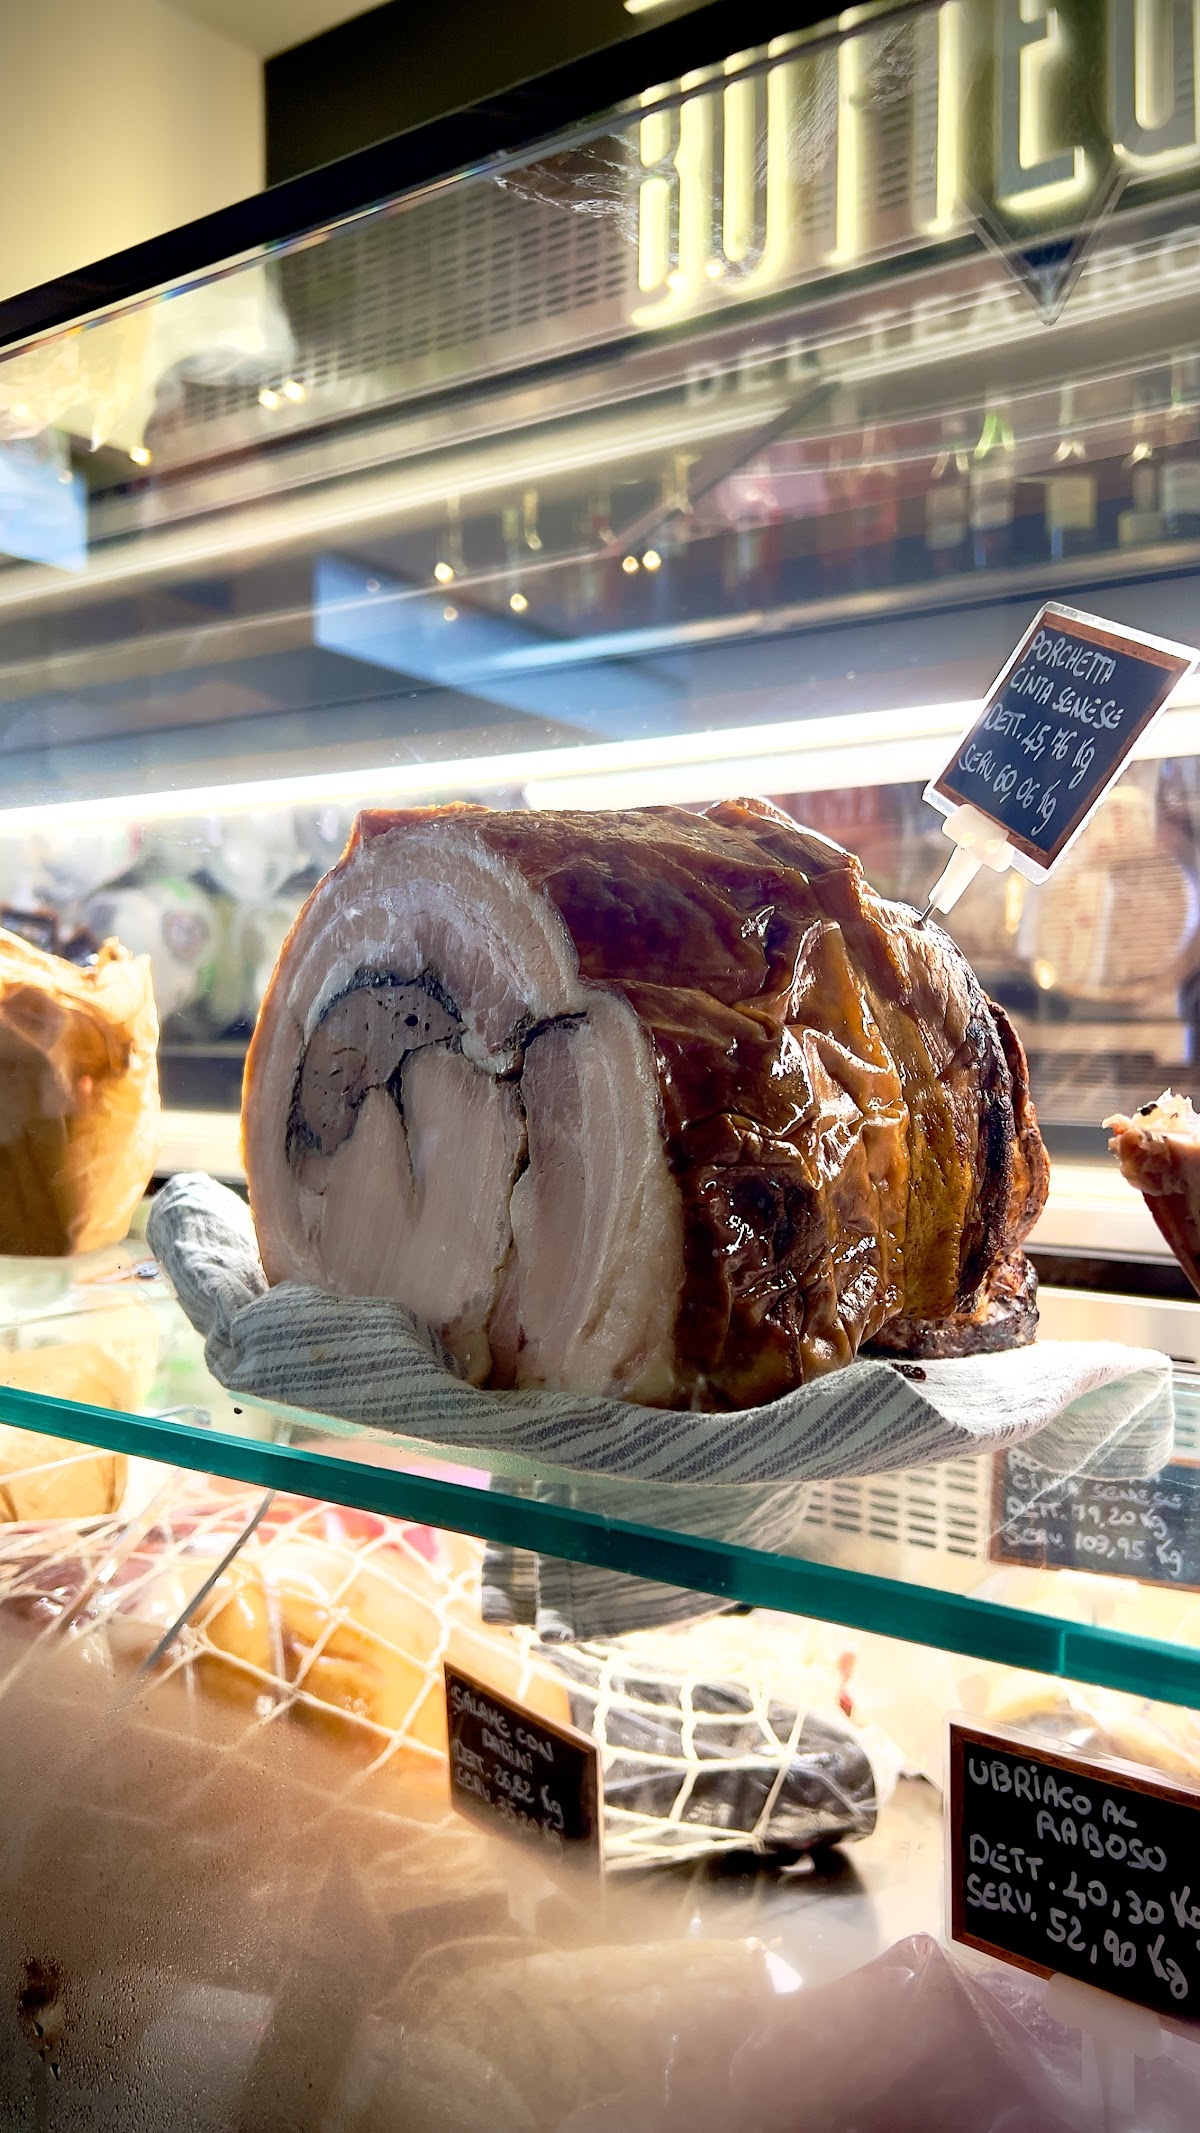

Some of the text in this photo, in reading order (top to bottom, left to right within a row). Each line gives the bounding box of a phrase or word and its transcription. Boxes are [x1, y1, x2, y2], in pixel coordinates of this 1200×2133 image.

[1021, 629, 1116, 684] PORCHETTA
[983, 702, 1026, 740] DETT.
[1009, 665, 1125, 730] CINTA SENESE
[1074, 1531, 1146, 1561] 103,95
[450, 1685, 555, 1763] SALAME CON
[968, 1757, 1138, 1829] UBRIACO AL
[1036, 1808, 1168, 1873] RABOSO
[1062, 1870, 1165, 1926] 40,30
[966, 1872, 1189, 2000] SERV. 52,90 Kg
